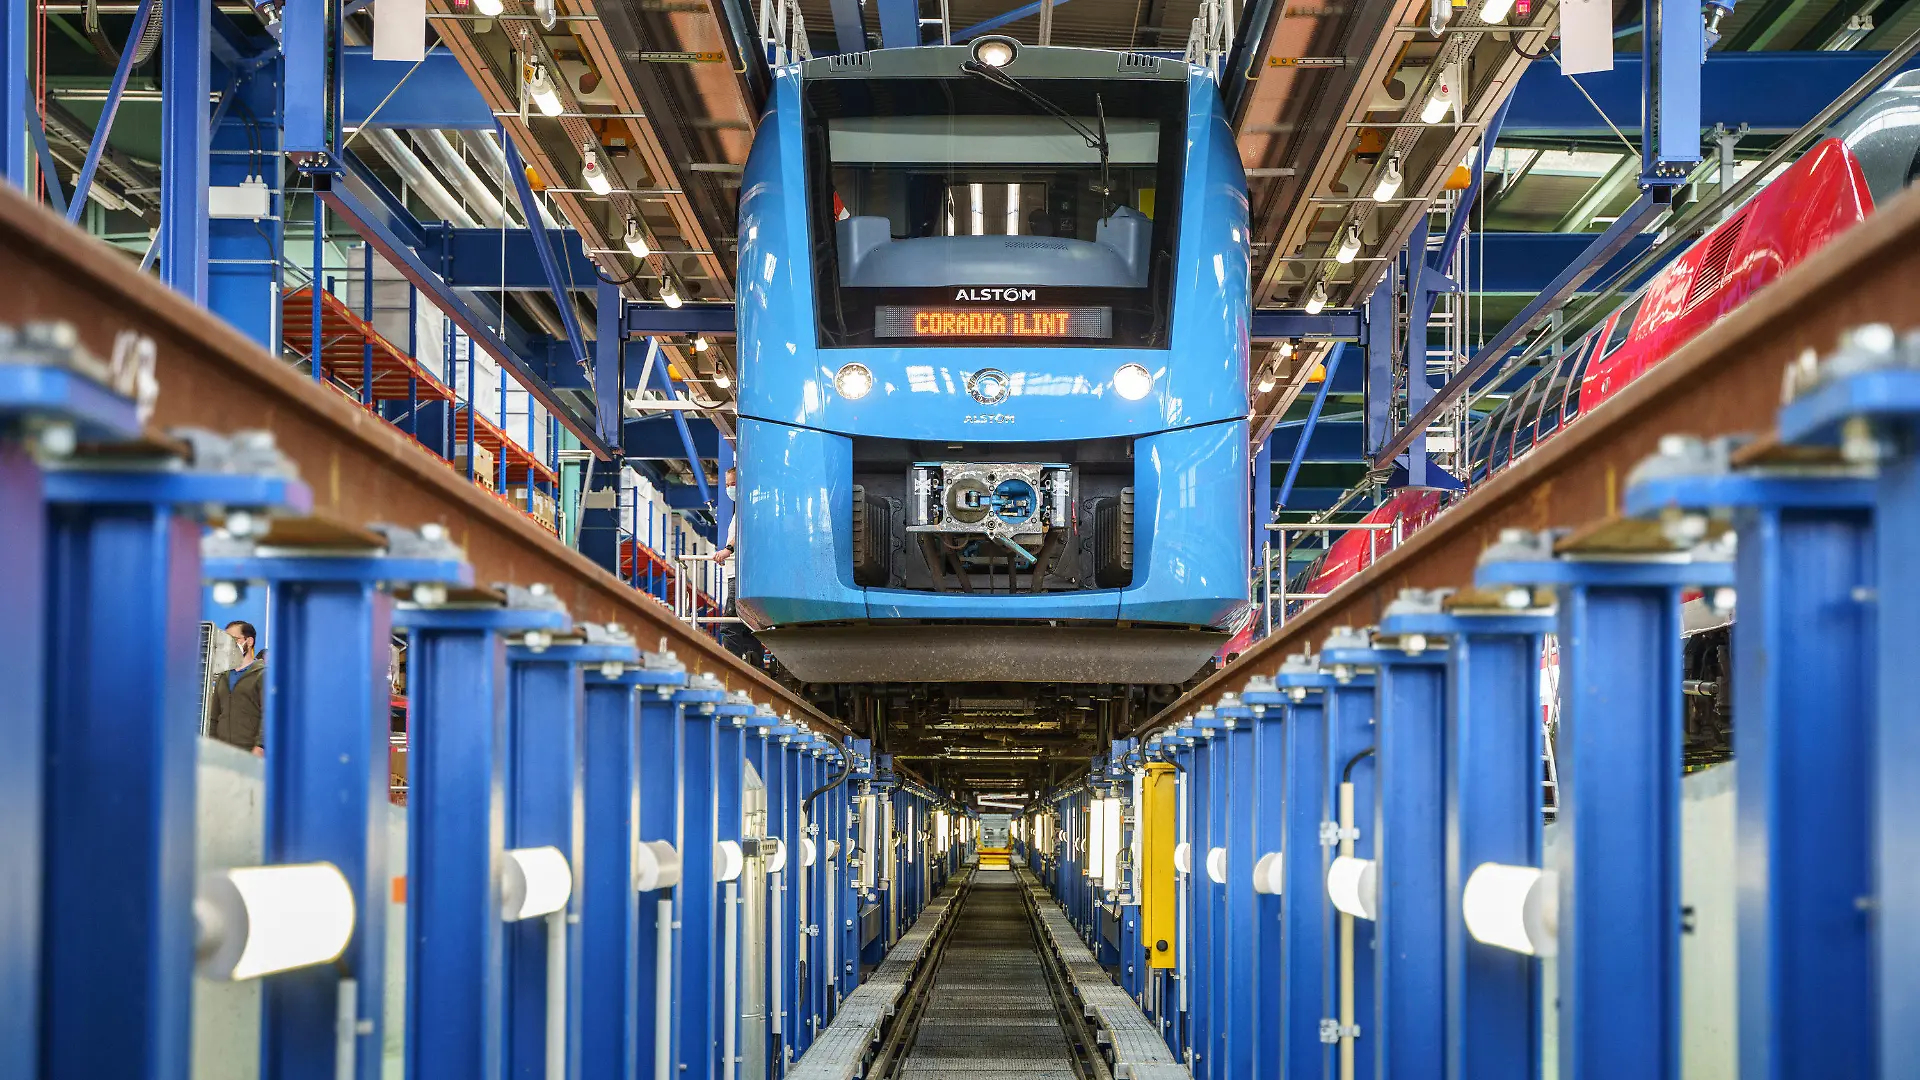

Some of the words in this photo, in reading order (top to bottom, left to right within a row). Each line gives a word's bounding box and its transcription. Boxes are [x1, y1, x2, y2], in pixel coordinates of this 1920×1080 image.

[955, 287, 1036, 302] ALSTOM
[915, 312, 1007, 335] CORADIA
[1013, 312, 1069, 334] iLINT
[963, 413, 1015, 424] ALSTOM
